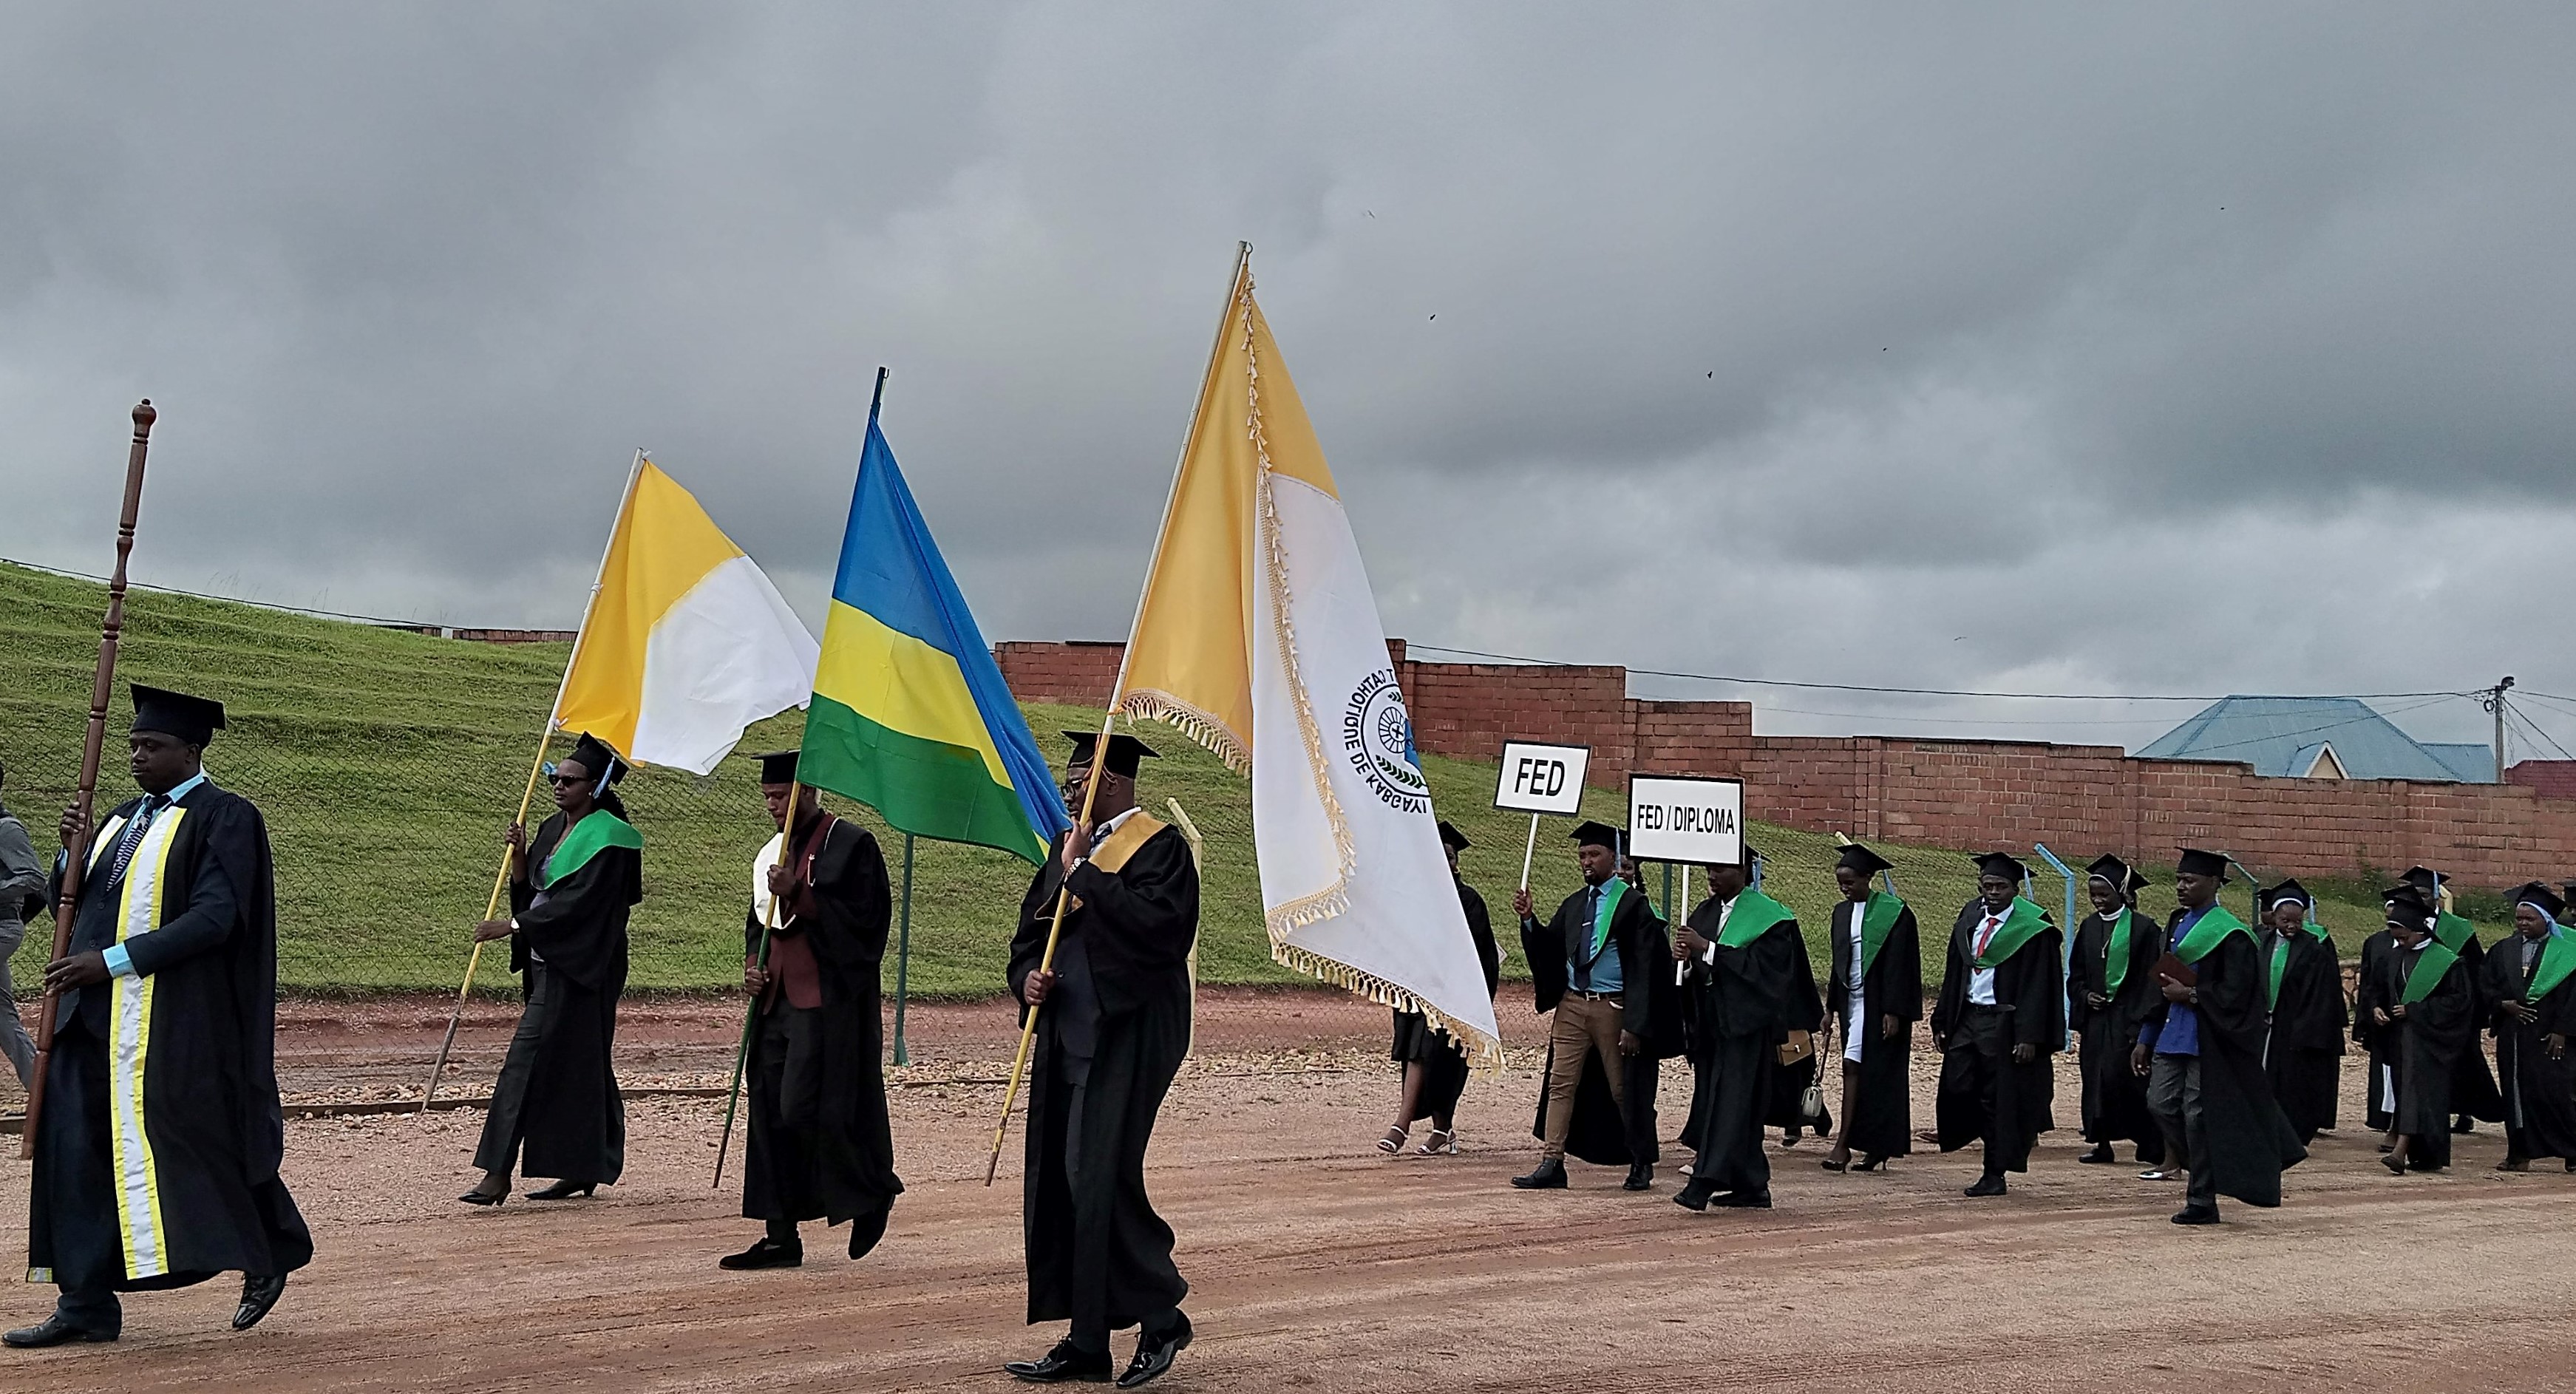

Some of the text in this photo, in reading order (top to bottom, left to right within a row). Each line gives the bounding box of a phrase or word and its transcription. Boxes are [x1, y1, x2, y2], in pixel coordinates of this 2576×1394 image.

[1514, 758, 1565, 797] FED
[1637, 804, 1663, 830] FED
[1674, 806, 1735, 834] DIPLOMA
